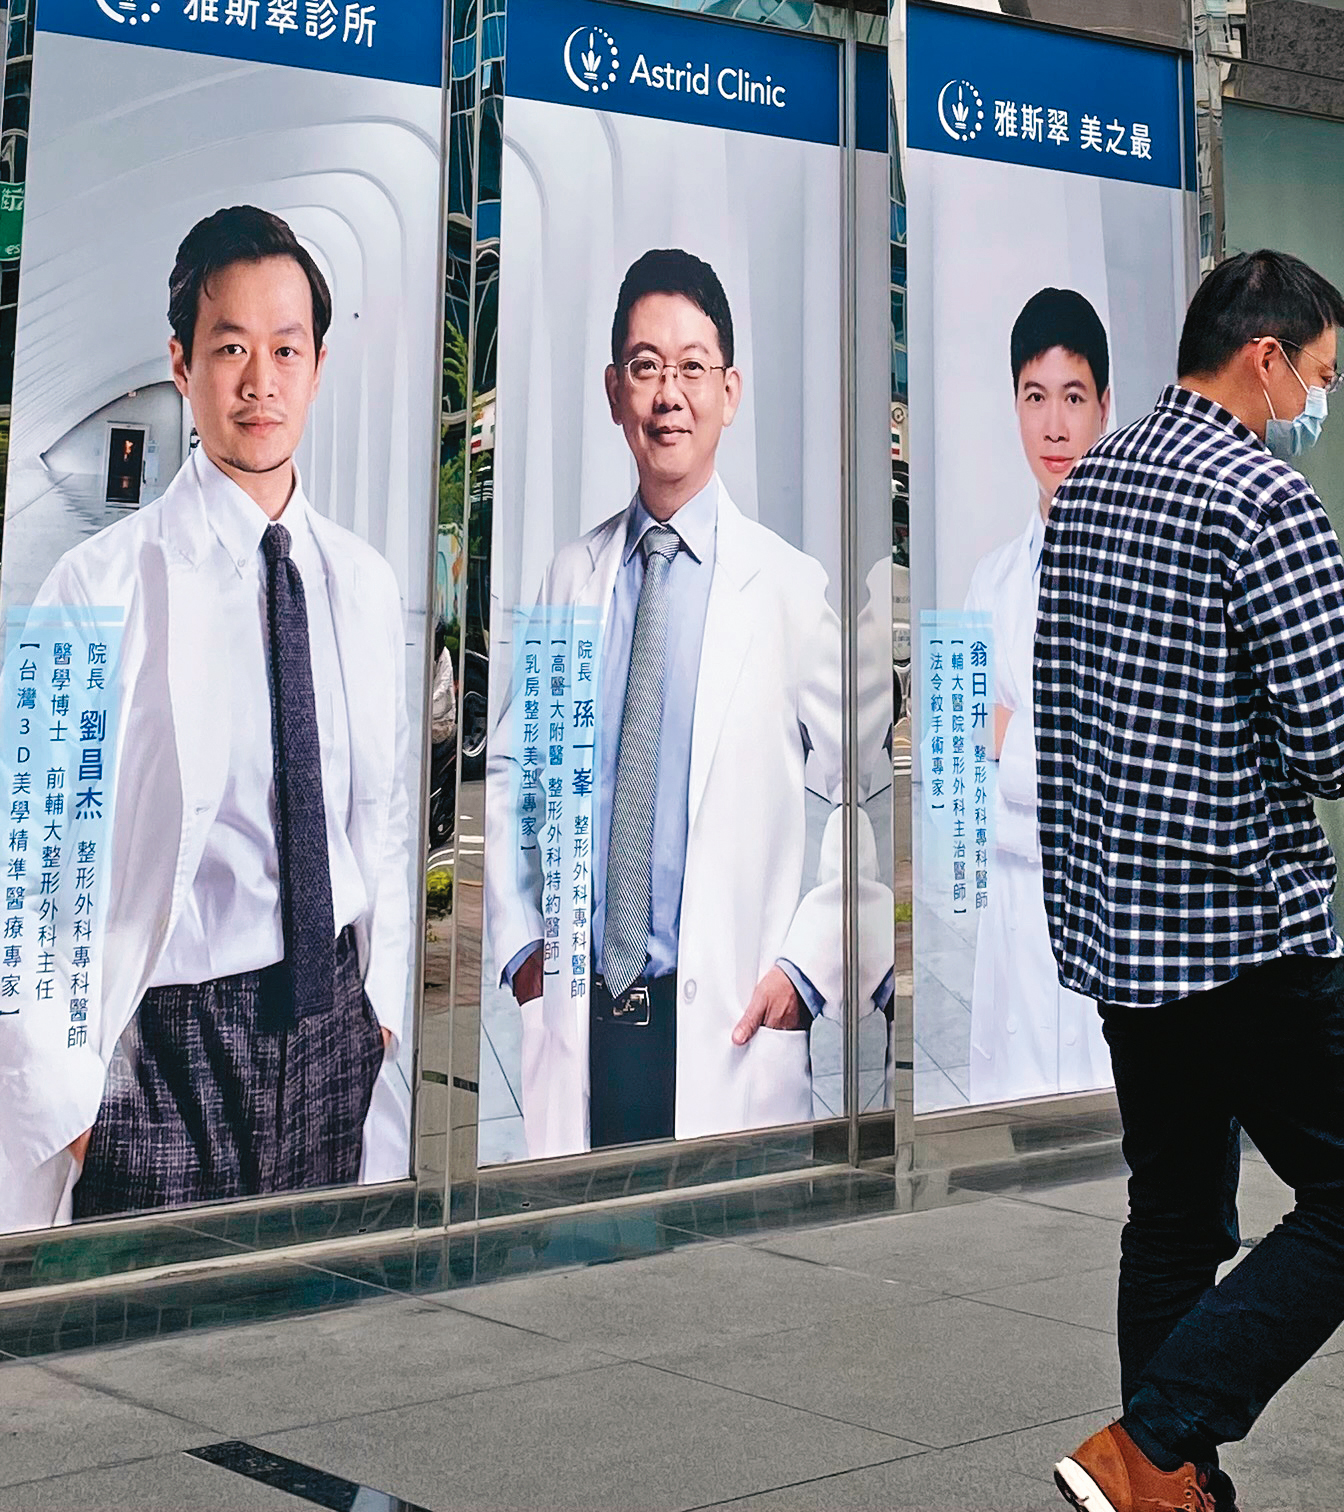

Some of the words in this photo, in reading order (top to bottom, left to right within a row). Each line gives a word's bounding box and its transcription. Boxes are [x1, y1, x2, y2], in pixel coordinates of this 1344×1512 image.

[629, 53, 710, 96] Astrid
[716, 67, 787, 109] Clinic
[993, 99, 1070, 146] 雅斯翠
[1080, 113, 1153, 161] 美之最
[49, 642, 73, 743] 醫學博士
[86, 642, 108, 691] 院長
[577, 639, 593, 682] 院長
[969, 640, 989, 729] 翁日升
[35, 766, 66, 1002] 前輔大整形外科主任
[67, 839, 96, 1050] 整形外科專科醫師
